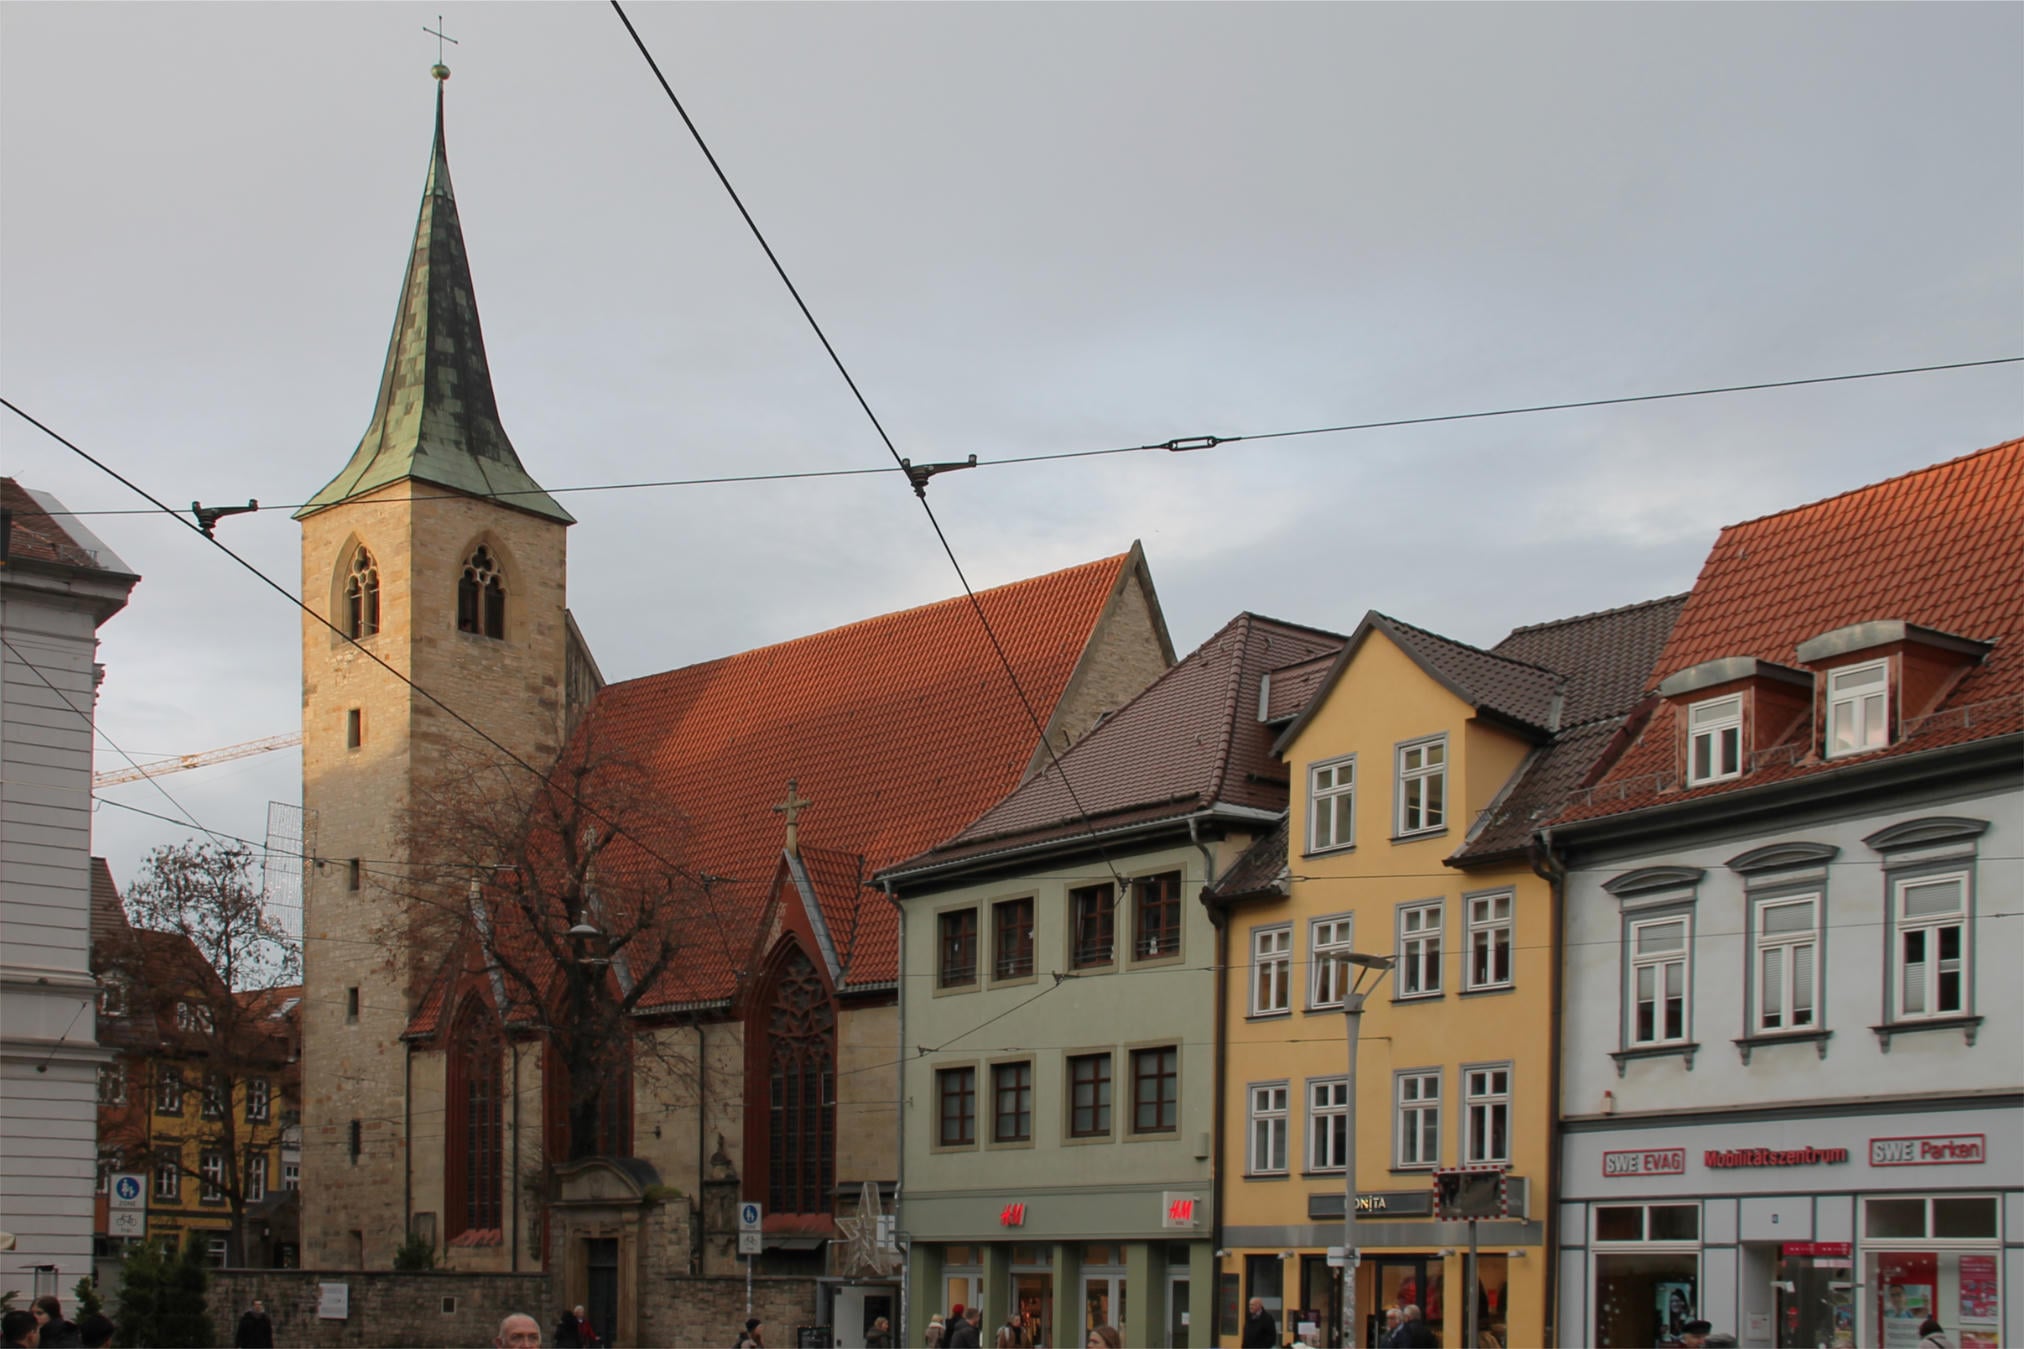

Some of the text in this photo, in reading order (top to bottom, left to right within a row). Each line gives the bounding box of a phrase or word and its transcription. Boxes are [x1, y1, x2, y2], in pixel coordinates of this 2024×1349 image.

[1704, 1145, 1847, 1168] Mobilitätszentrum
[1874, 1141, 1979, 1161] SWE Parken
[1606, 1152, 1681, 1173] SWE EVAG
